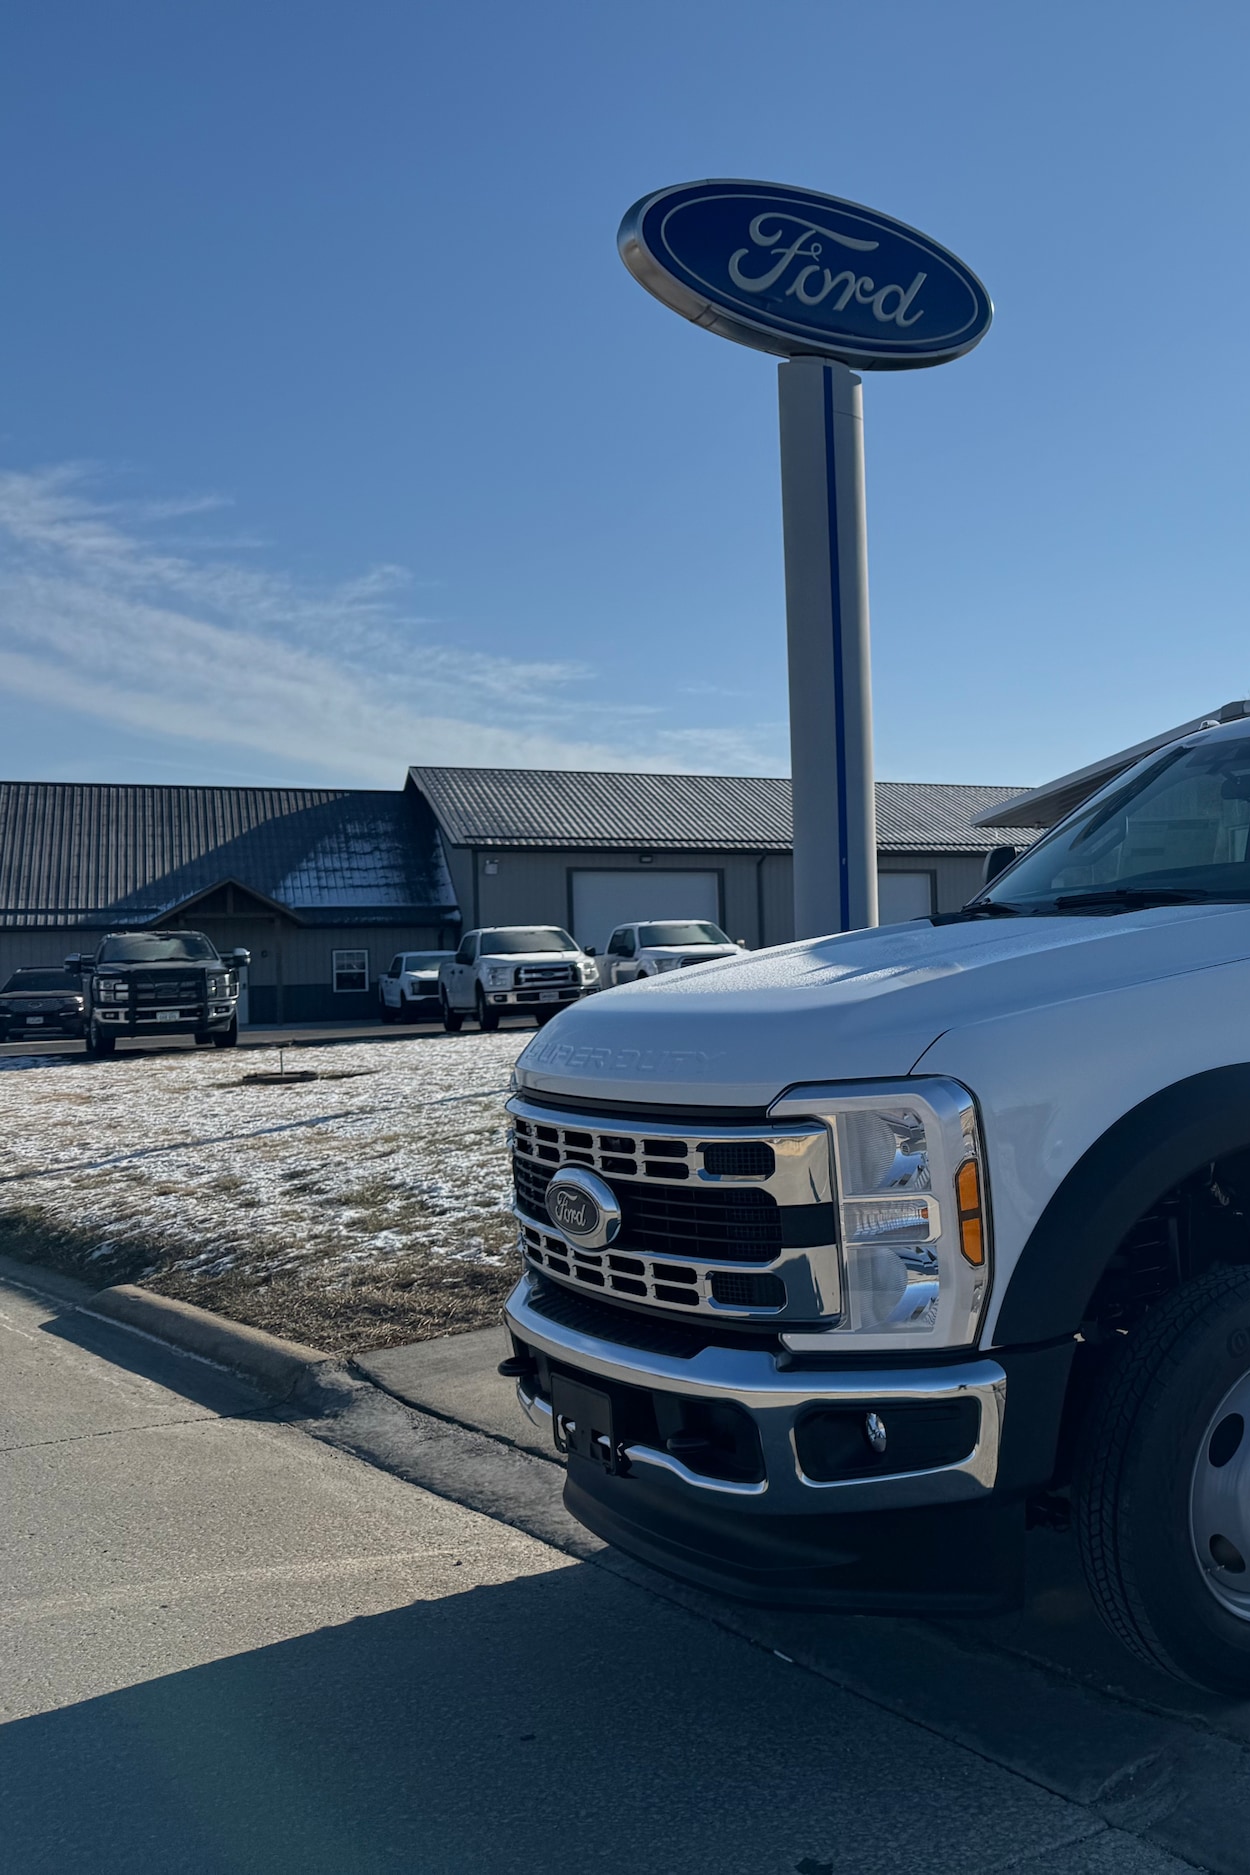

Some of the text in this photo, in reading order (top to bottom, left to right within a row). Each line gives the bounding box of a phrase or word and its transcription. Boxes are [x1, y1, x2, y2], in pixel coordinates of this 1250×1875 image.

[728, 212, 927, 328] Ford
[525, 1043, 727, 1075] SUPER DUTY
[555, 1190, 587, 1227] Ford
